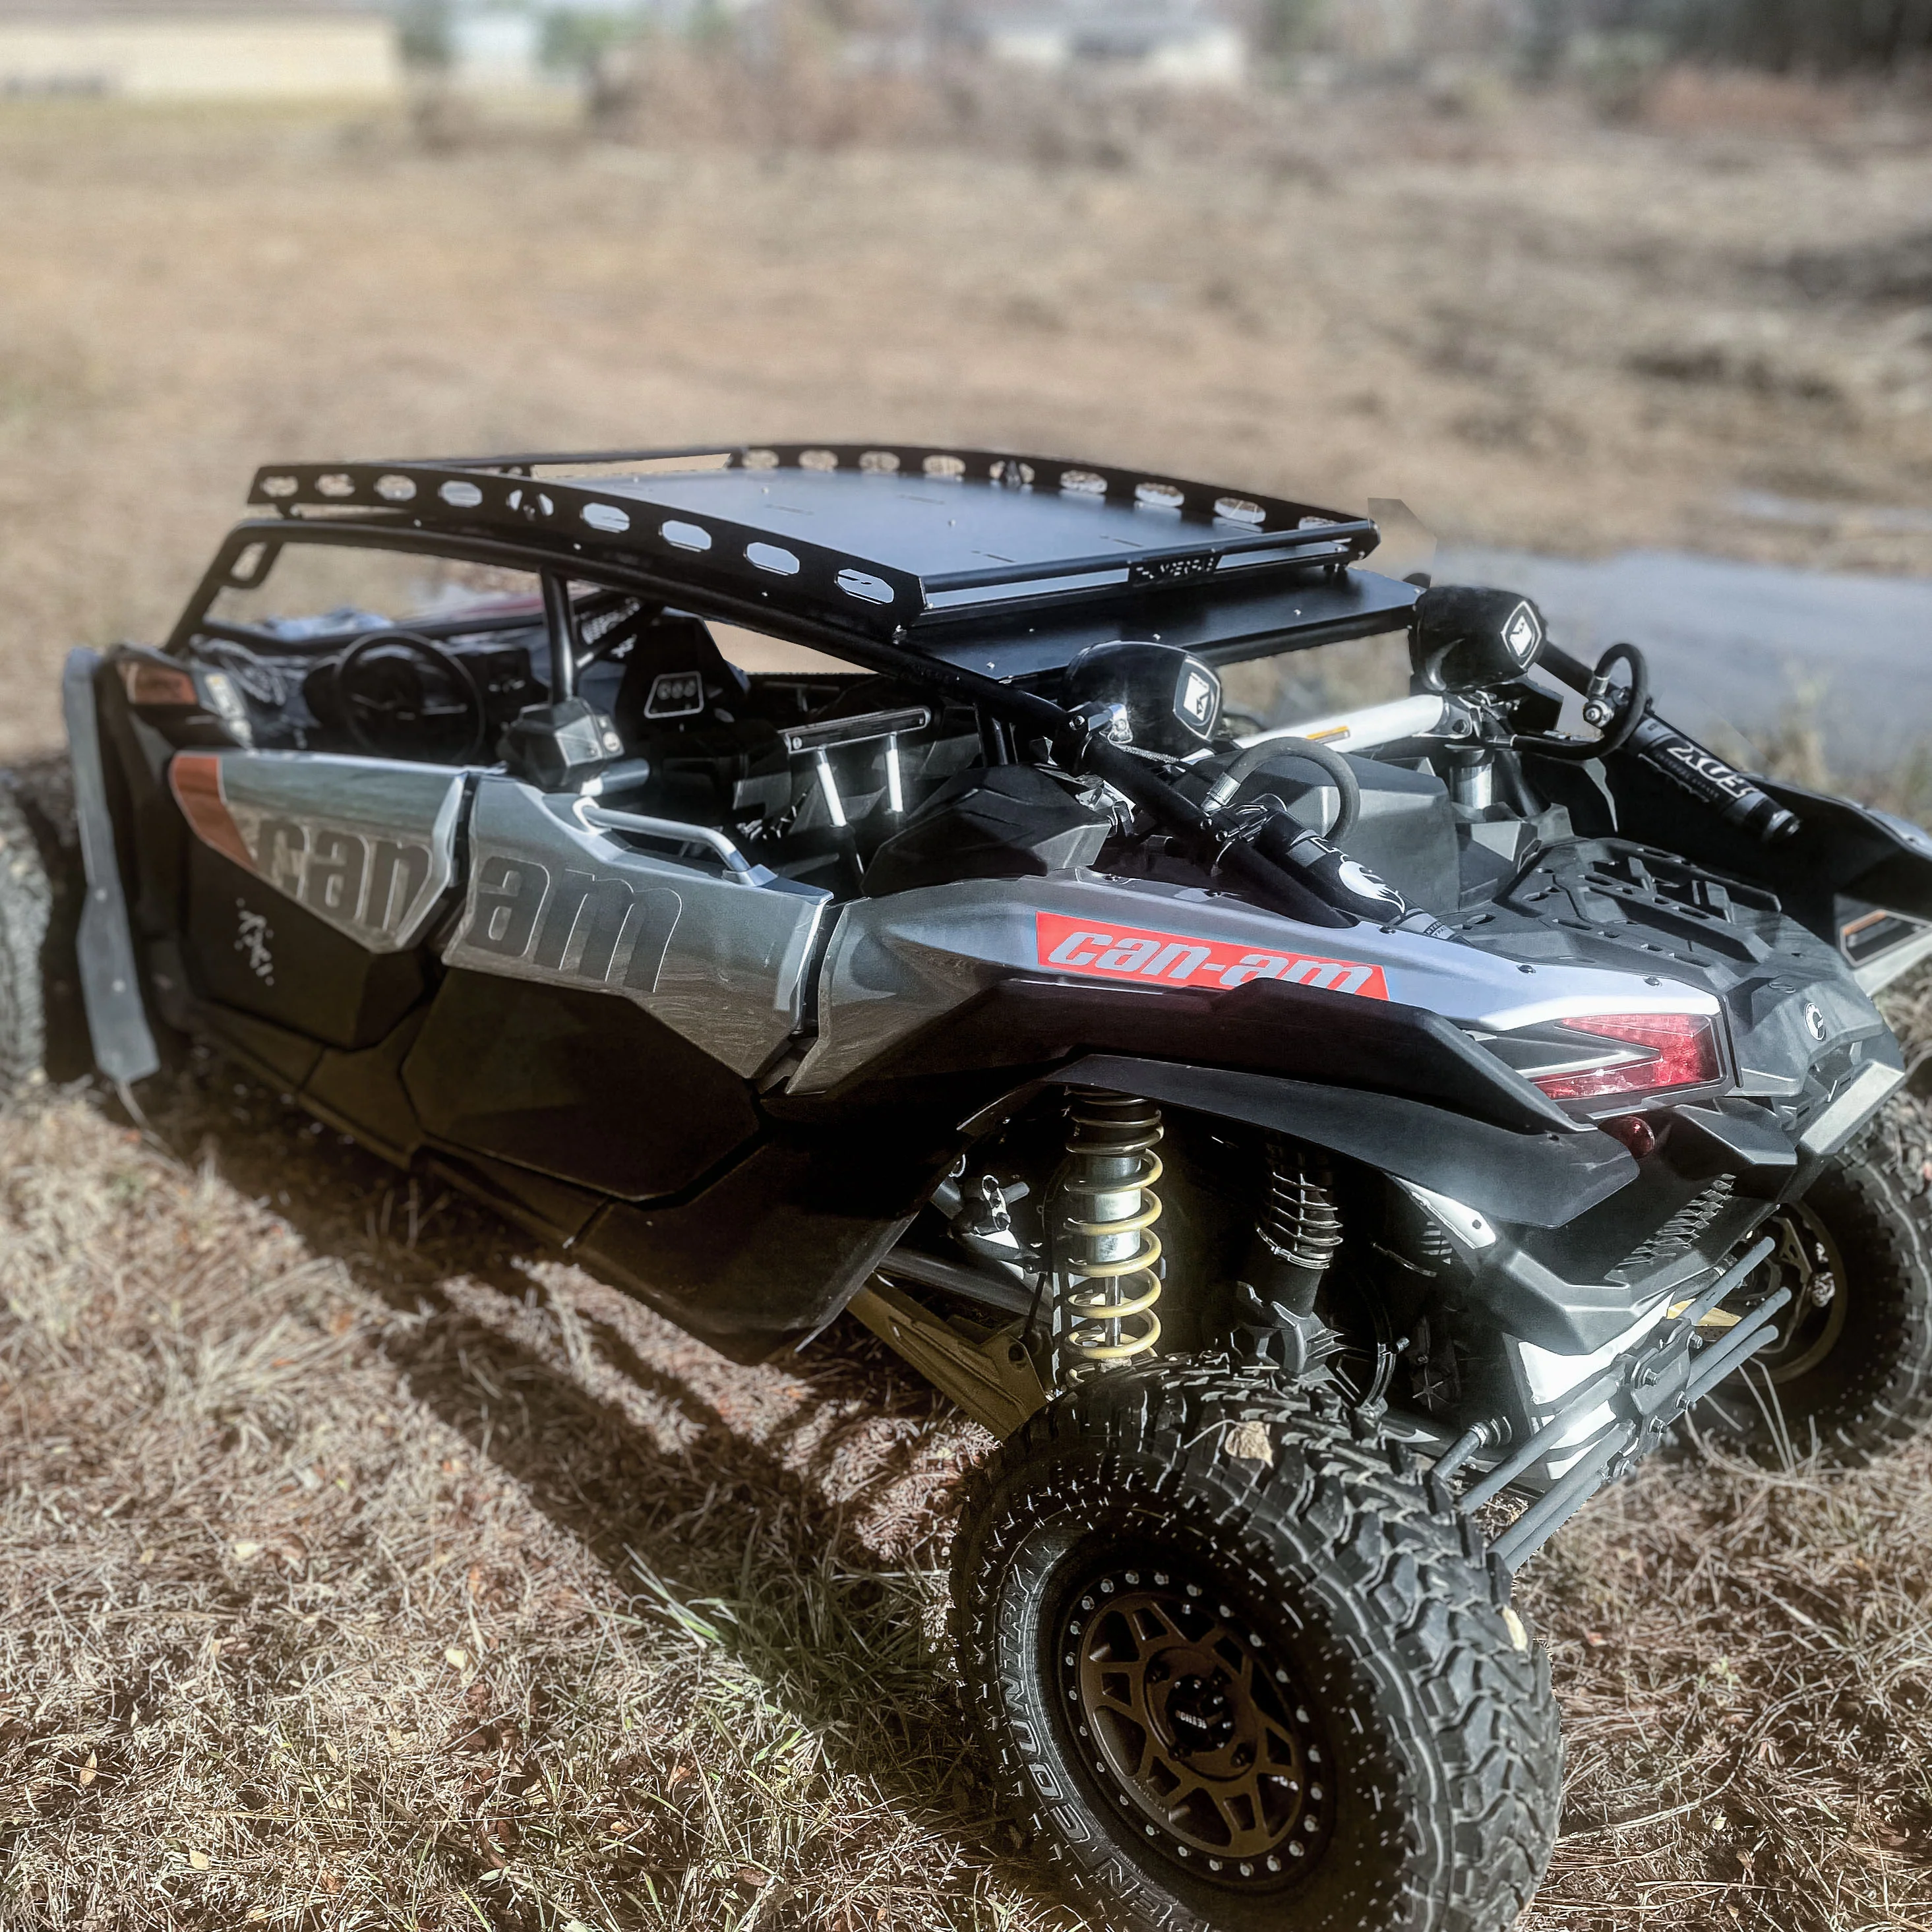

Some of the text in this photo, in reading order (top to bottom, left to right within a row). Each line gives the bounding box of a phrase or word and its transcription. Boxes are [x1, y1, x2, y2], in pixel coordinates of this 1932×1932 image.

[464, 855, 683, 993] am
[1050, 931, 1373, 994] can-am
[998, 1563, 1091, 1844] COUNTRY
